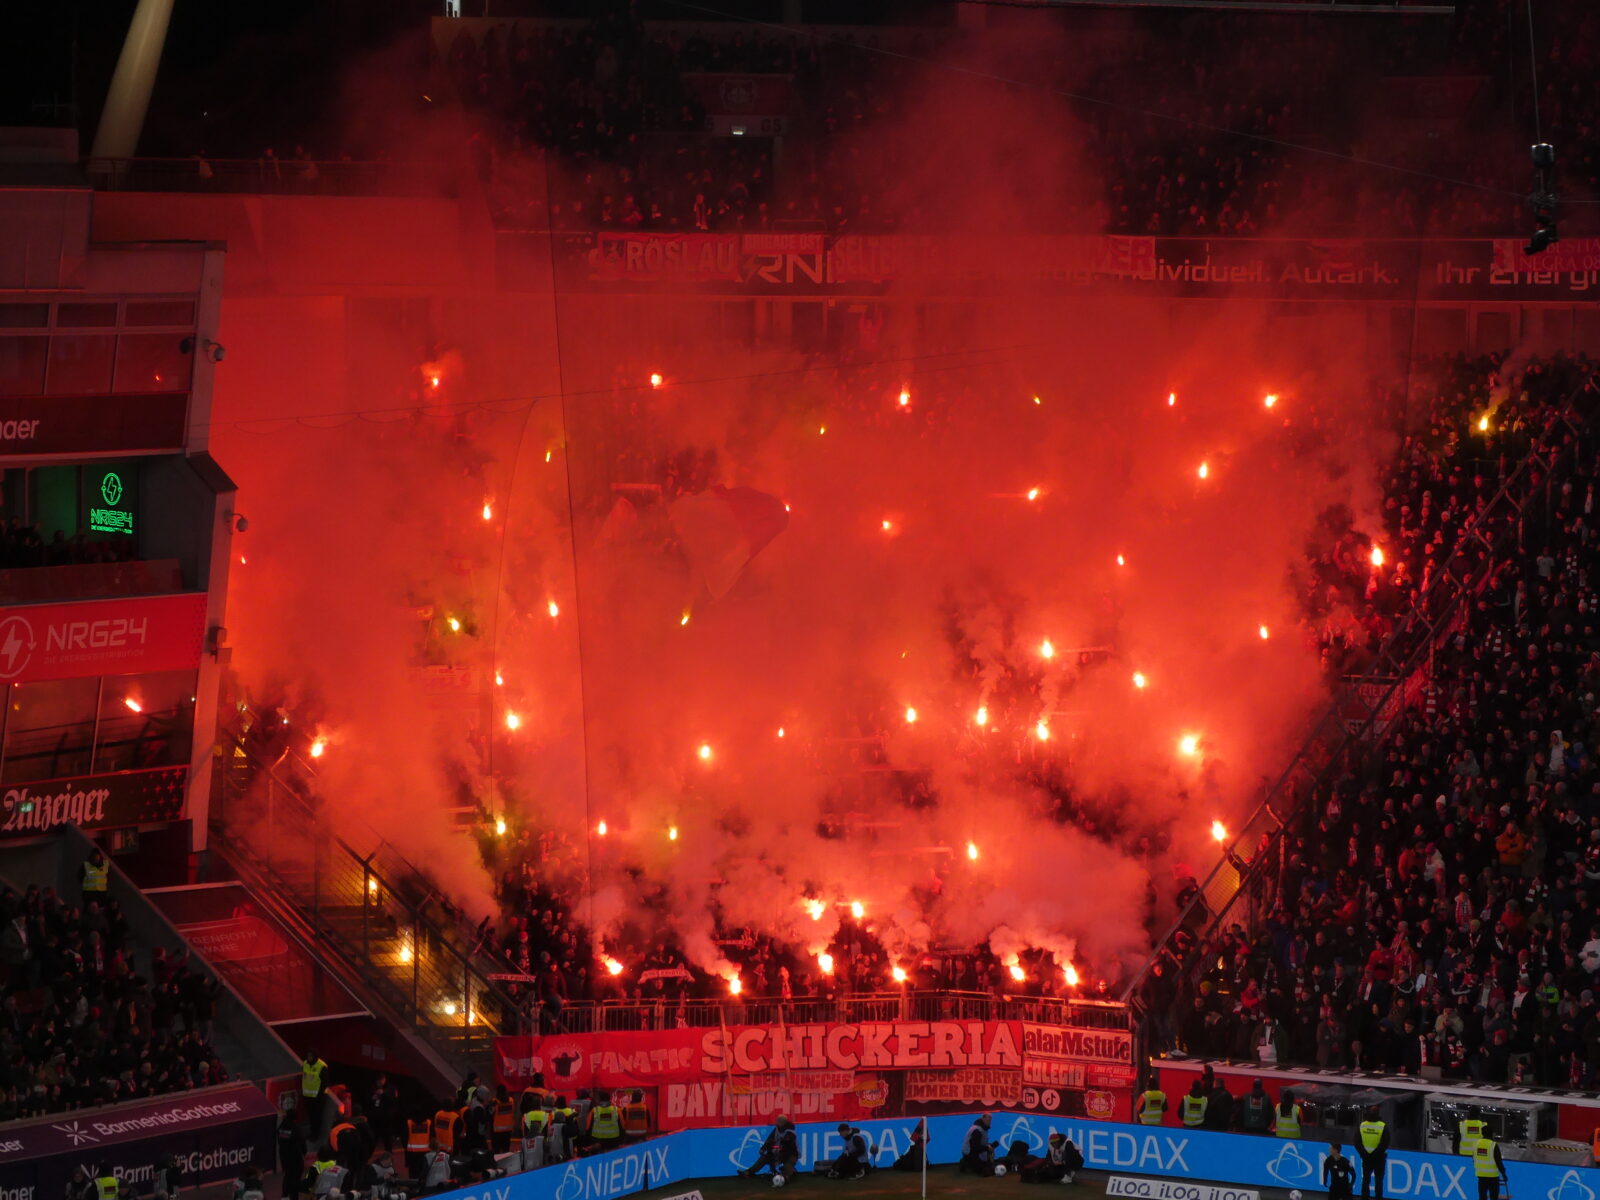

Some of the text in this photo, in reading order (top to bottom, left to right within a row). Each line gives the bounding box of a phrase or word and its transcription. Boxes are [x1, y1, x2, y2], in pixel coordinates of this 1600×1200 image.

[1436, 262, 1481, 285] Ihr
[0, 419, 40, 440] aer
[45, 616, 149, 653] NRG24
[2, 783, 110, 832] Anzeiger
[590, 1047, 694, 1075] FANATIC
[701, 1021, 1023, 1075] SCHICKERIA
[1025, 1031, 1131, 1062] alarMstufe
[1024, 1060, 1085, 1087] COLEGIO
[963, 1084, 988, 1098] BEI
[991, 1085, 1020, 1099] UNS
[93, 1100, 242, 1137] BarmeniaGothaer
[585, 1145, 670, 1200] NIEDAX
[1110, 1178, 1152, 1196] iLOQ
[1159, 1183, 1201, 1200] iLOQ
